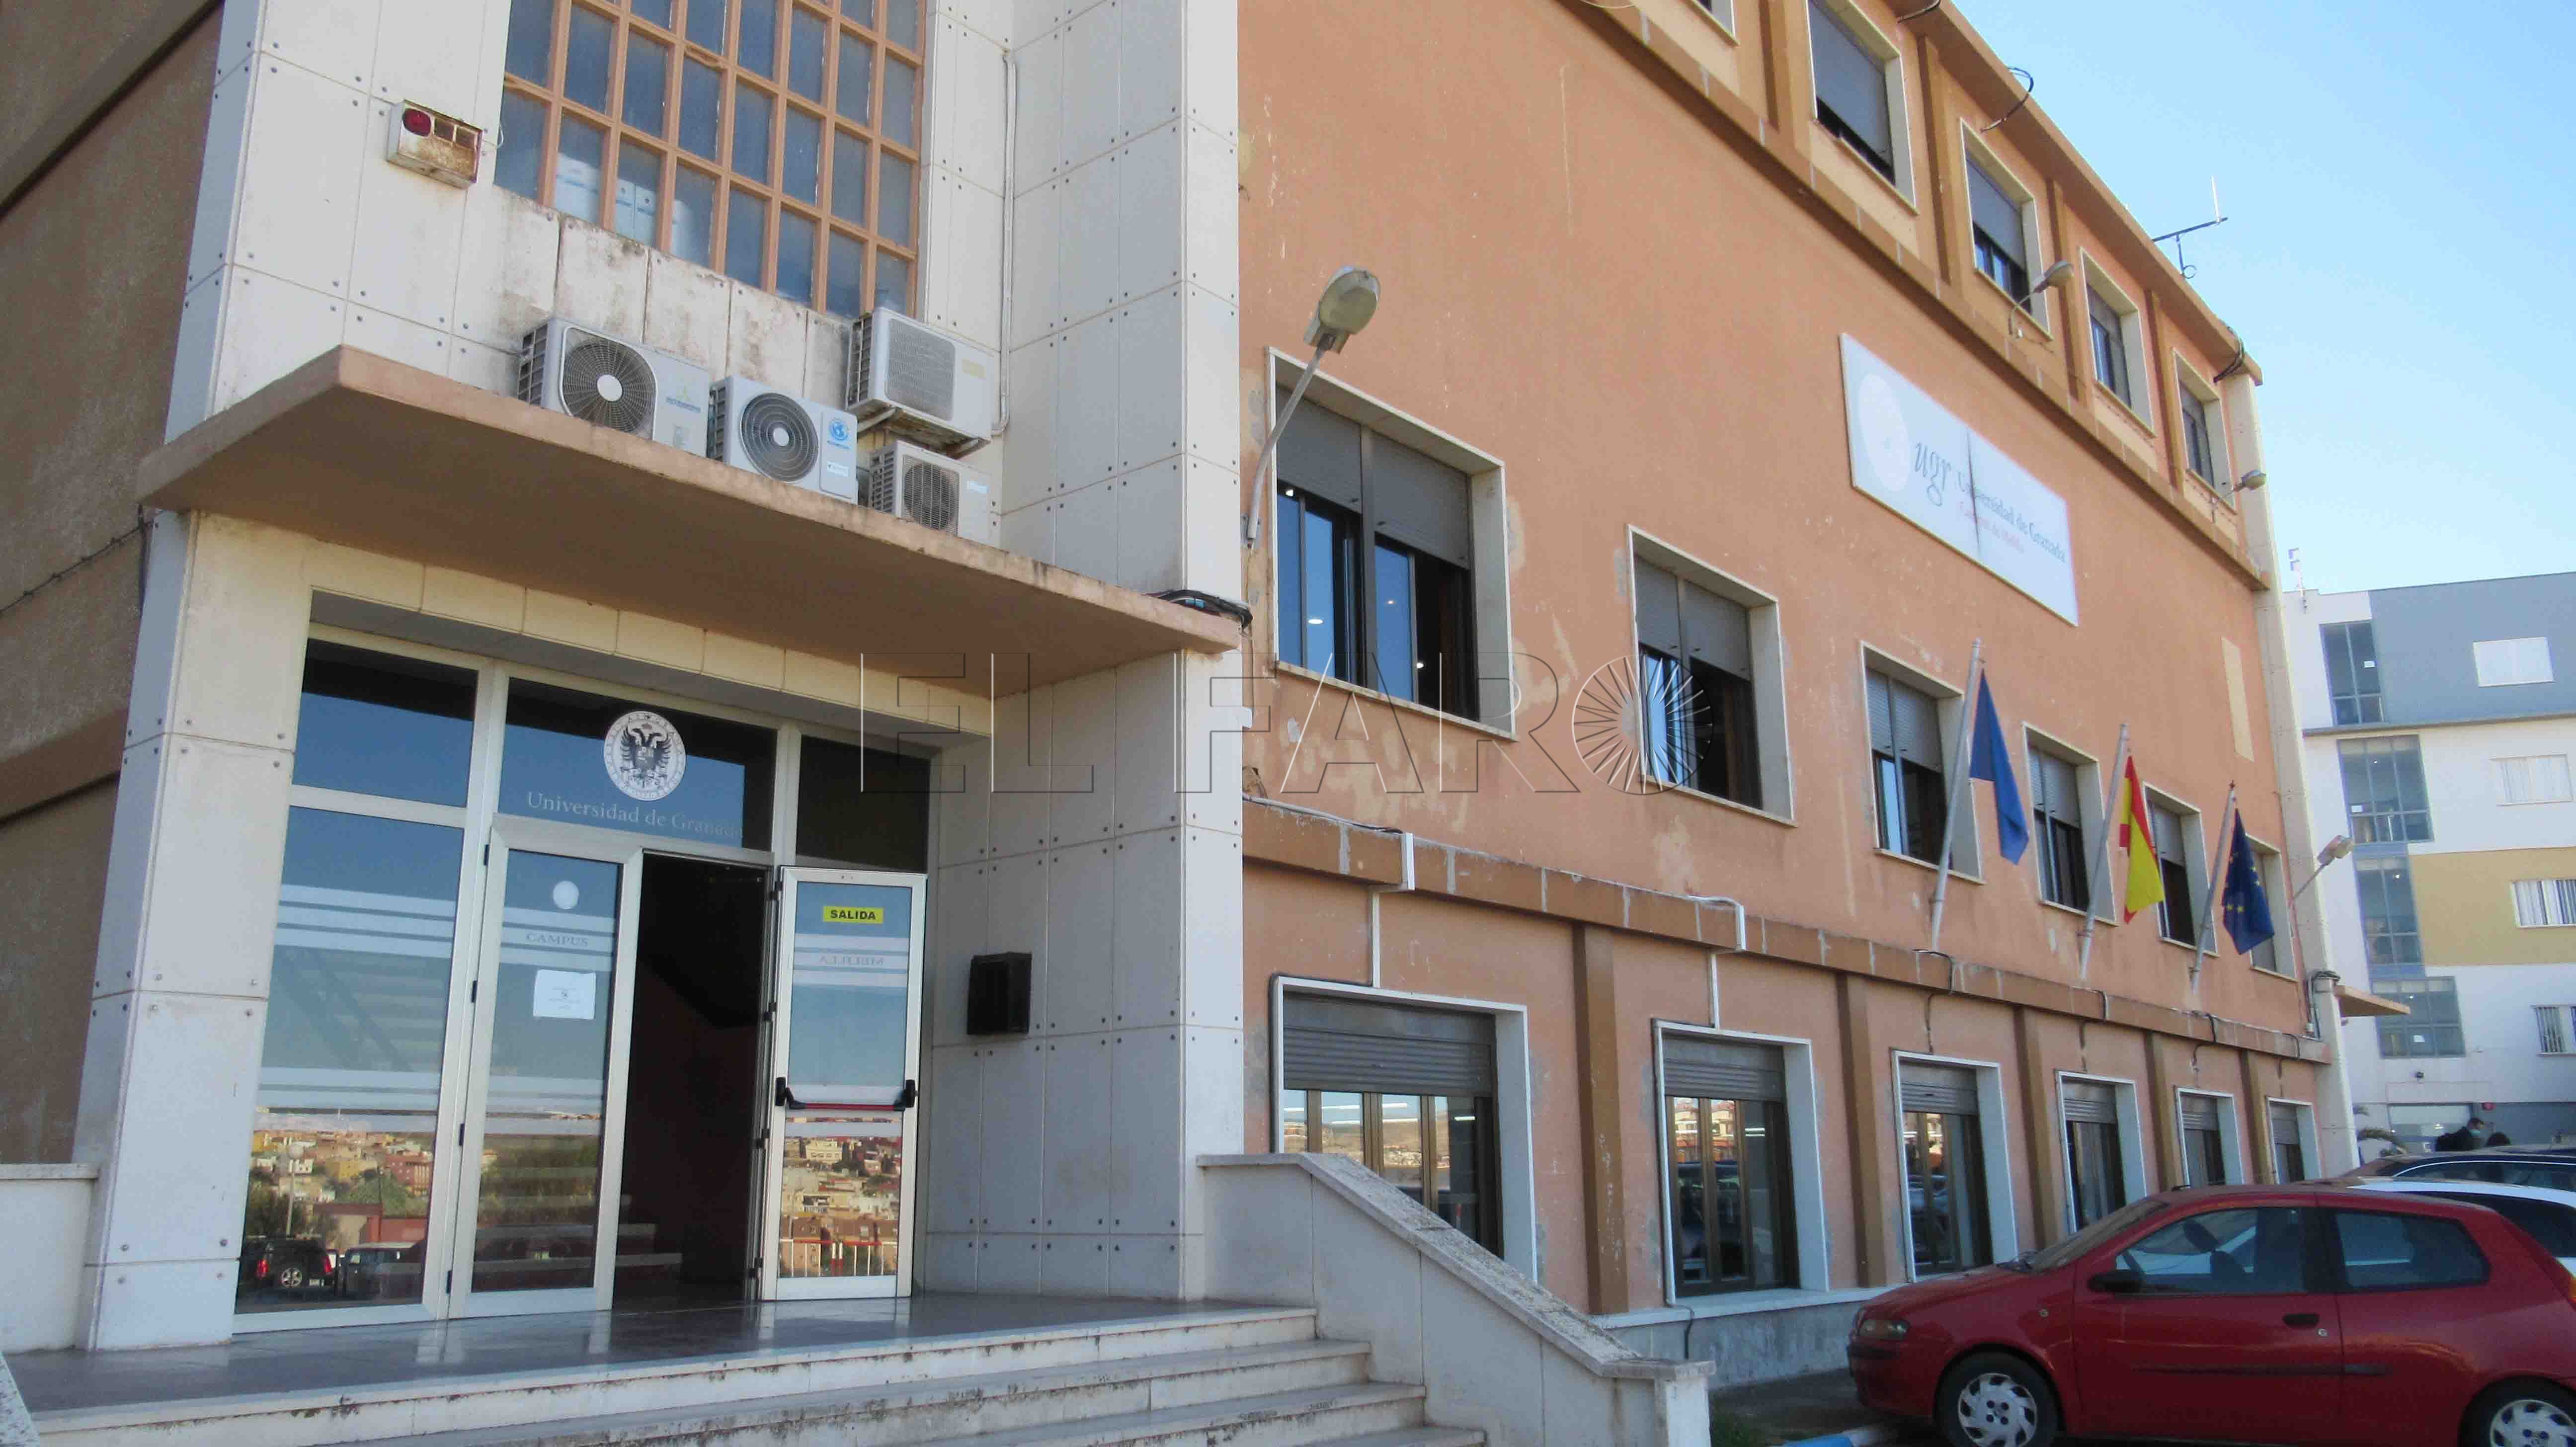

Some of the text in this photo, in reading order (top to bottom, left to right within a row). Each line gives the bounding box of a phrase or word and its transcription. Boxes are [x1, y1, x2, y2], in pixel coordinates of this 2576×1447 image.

[1915, 442, 1951, 507] ugr
[1956, 470, 2013, 525] Uversidad
[527, 791, 640, 824] Universidad
[644, 808, 666, 828] de
[830, 910, 876, 920] SALIDA
[526, 934, 589, 947] CAMPUS
